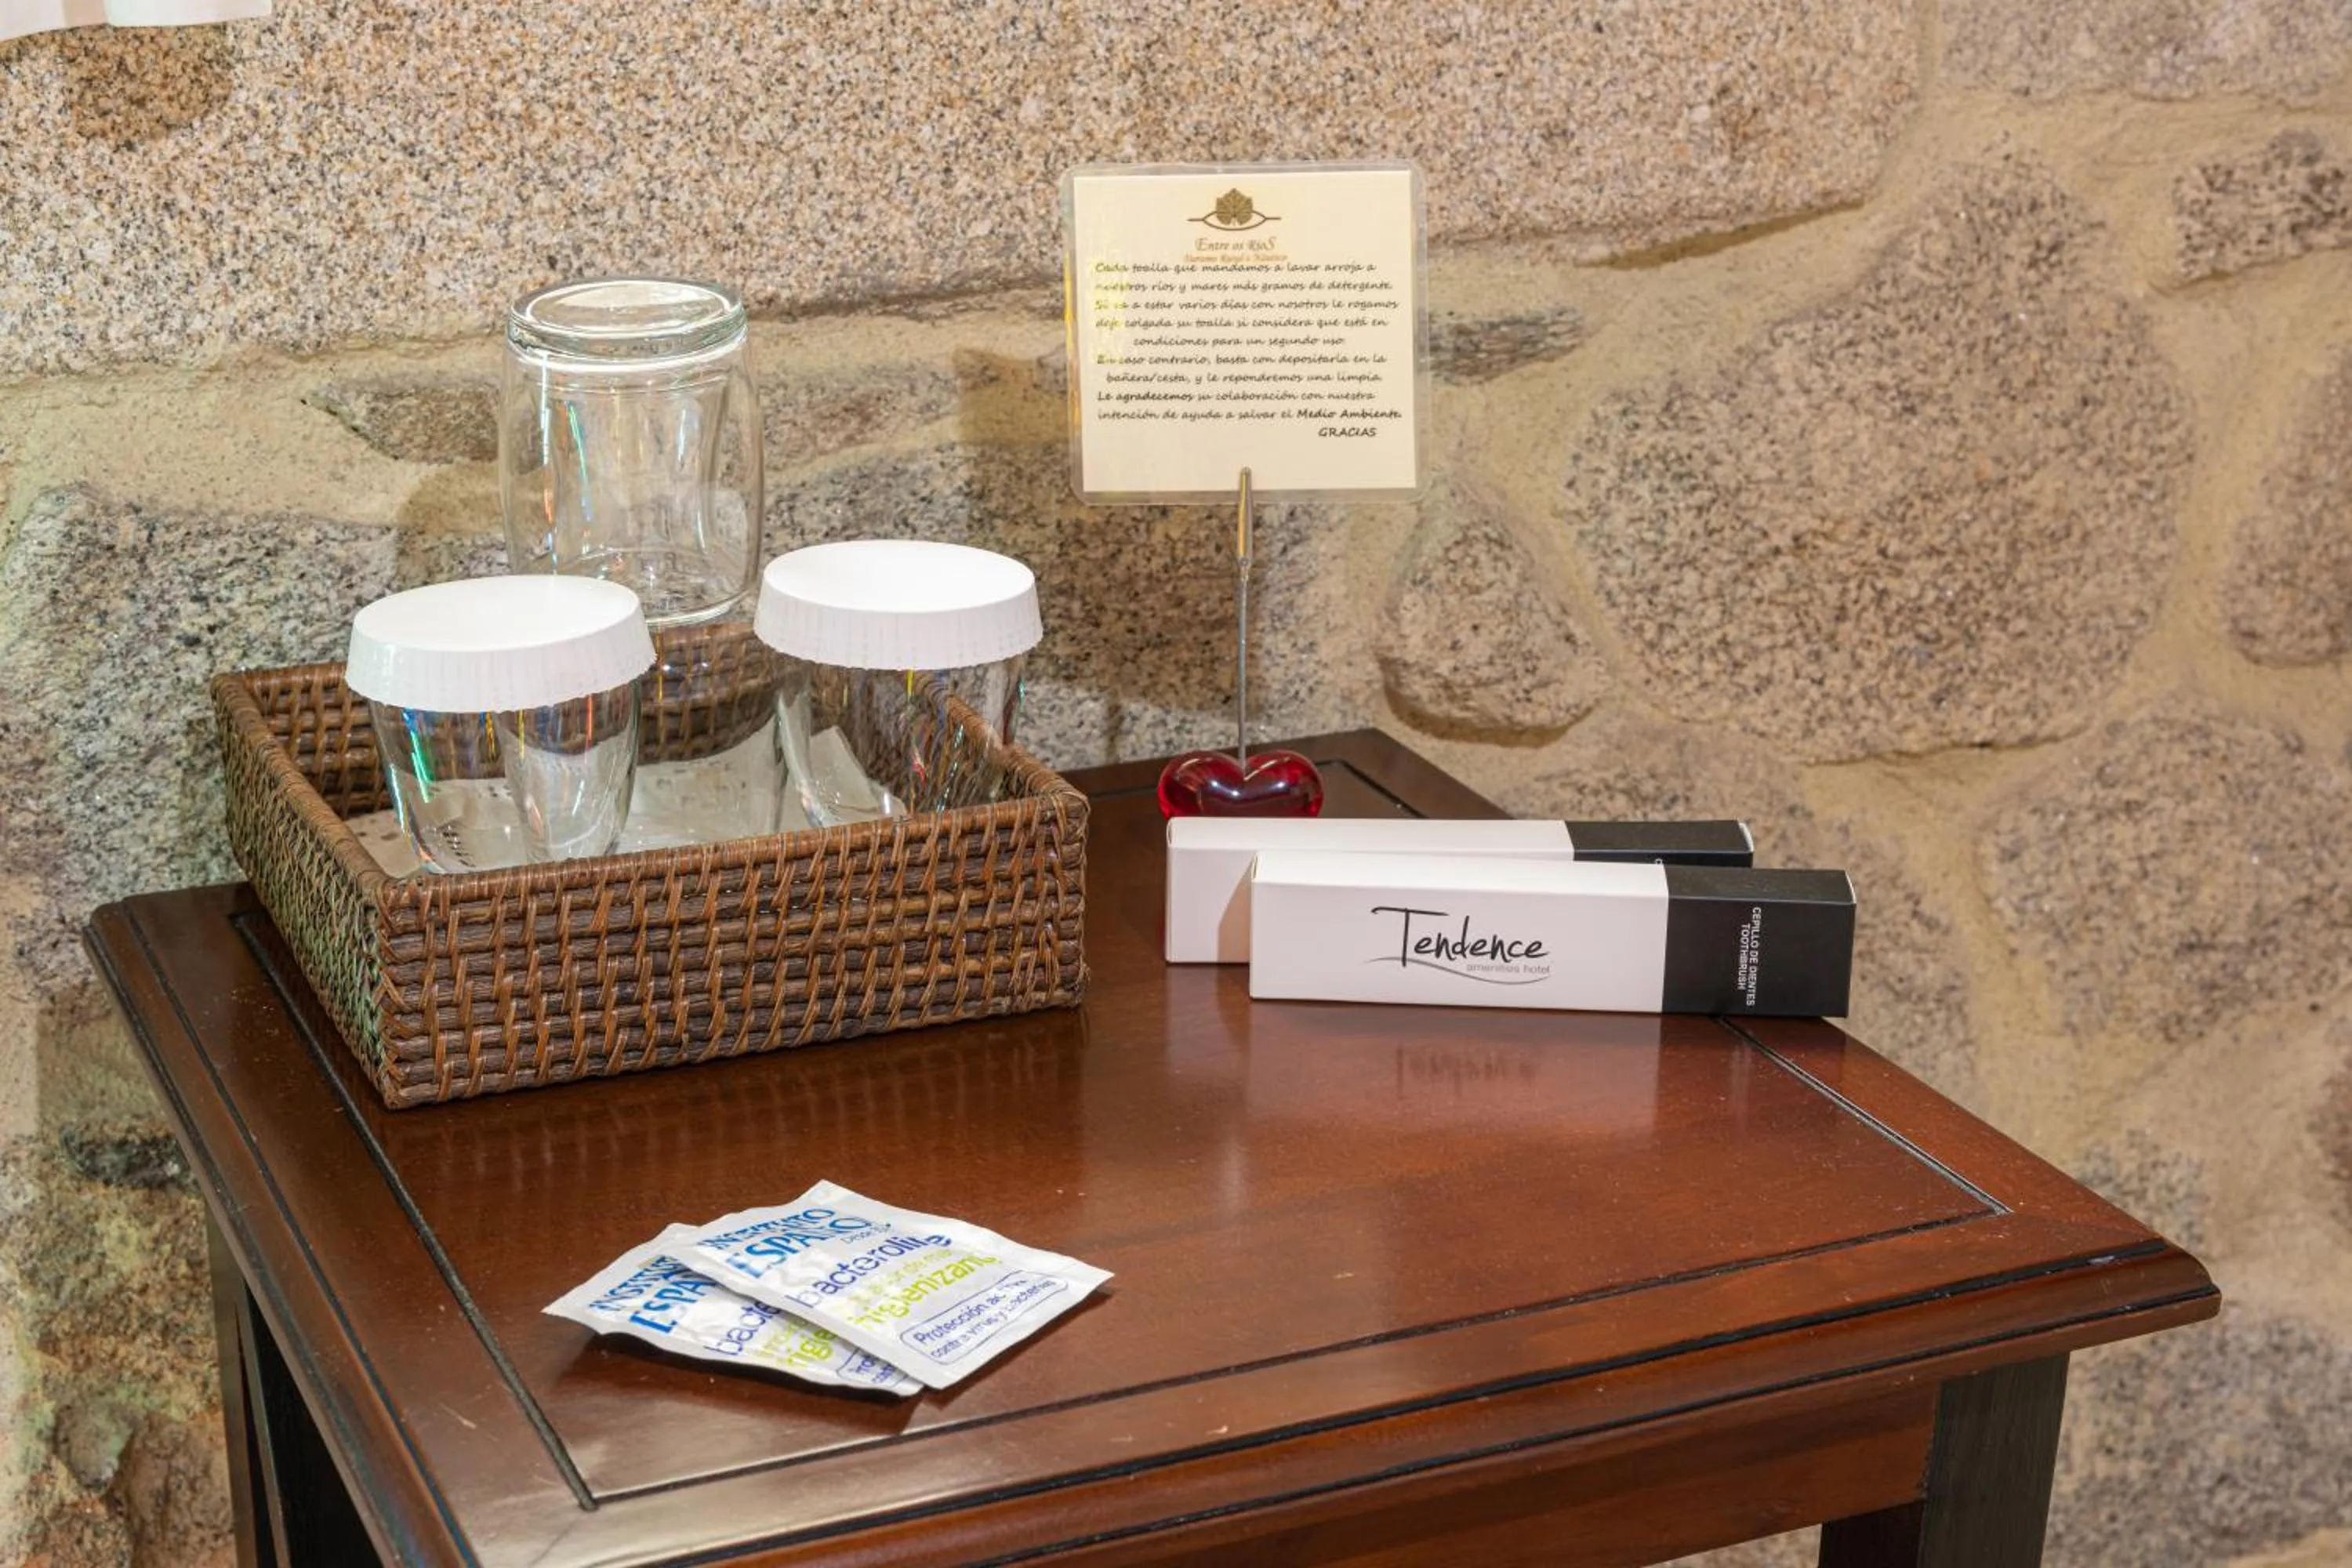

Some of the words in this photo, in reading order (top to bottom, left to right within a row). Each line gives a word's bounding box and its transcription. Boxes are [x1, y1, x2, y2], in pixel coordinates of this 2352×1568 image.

[1194, 237, 1230, 252] Entre
[1095, 263, 1128, 273] Cada
[1132, 263, 1170, 273] toalla
[1174, 263, 1197, 274] que
[1202, 262, 1270, 273] mandamos
[1287, 262, 1321, 272] lavar
[1324, 263, 1364, 274] arroja
[1095, 281, 1147, 292] nuestros
[1178, 283, 1186, 294] y
[1191, 282, 1229, 292] mares
[1232, 281, 1259, 291] más
[1261, 282, 1305, 293] gramos
[1308, 281, 1324, 290] de
[1145, 300, 1174, 310] estar
[1178, 299, 1216, 310] varios
[1251, 300, 1275, 310] con
[1278, 299, 1329, 310] nosotros
[1333, 298, 1344, 309] le
[1348, 299, 1399, 311] rogamos
[1125, 318, 1173, 331] colgada
[1177, 319, 1192, 328] su
[1196, 318, 1232, 328] toalla
[1236, 318, 1249, 328] si
[1252, 318, 1313, 328] considera
[1317, 319, 1341, 329] que
[1372, 318, 1389, 327] en
[1133, 336, 1209, 347] condiciones
[1212, 338, 1243, 347] para
[1269, 335, 1320, 348] segundo
[1119, 356, 1145, 366] caso
[1216, 354, 1250, 365] basta
[1252, 356, 1276, 365] con
[1279, 353, 1349, 366] depositarla
[1352, 355, 1370, 364] en
[1374, 353, 1388, 363] la
[1195, 374, 1203, 385] y
[1207, 372, 1220, 383] le
[1222, 372, 1303, 384] repondremos
[1307, 373, 1333, 382] una
[1098, 391, 1112, 401] Le
[1116, 390, 1194, 404] agradecemos
[1198, 393, 1212, 401] su
[1216, 390, 1298, 401] colaboración
[1301, 391, 1325, 401] con
[1327, 391, 1377, 401] nuestra
[1098, 409, 1160, 420] intención
[1162, 409, 1178, 419] de
[1181, 409, 1221, 423] ayuda
[1238, 408, 1276, 419] salvar
[1280, 408, 1293, 419] el
[1297, 407, 1337, 419] Medio
[1339, 407, 1403, 419] Ambiente.
[1318, 426, 1377, 438] GRACIAS
[1750, 906, 1762, 949] CEPILLO
[1370, 906, 1550, 967] Tendence
[1737, 924, 1751, 991] TOOTHBRUSH
[1749, 950, 1759, 964] DE
[1523, 964, 1550, 975] hotel
[1746, 966, 1759, 1007] DIENTES
[589, 1255, 690, 1311] INSTITUT
[913, 1303, 989, 1345] Protección
